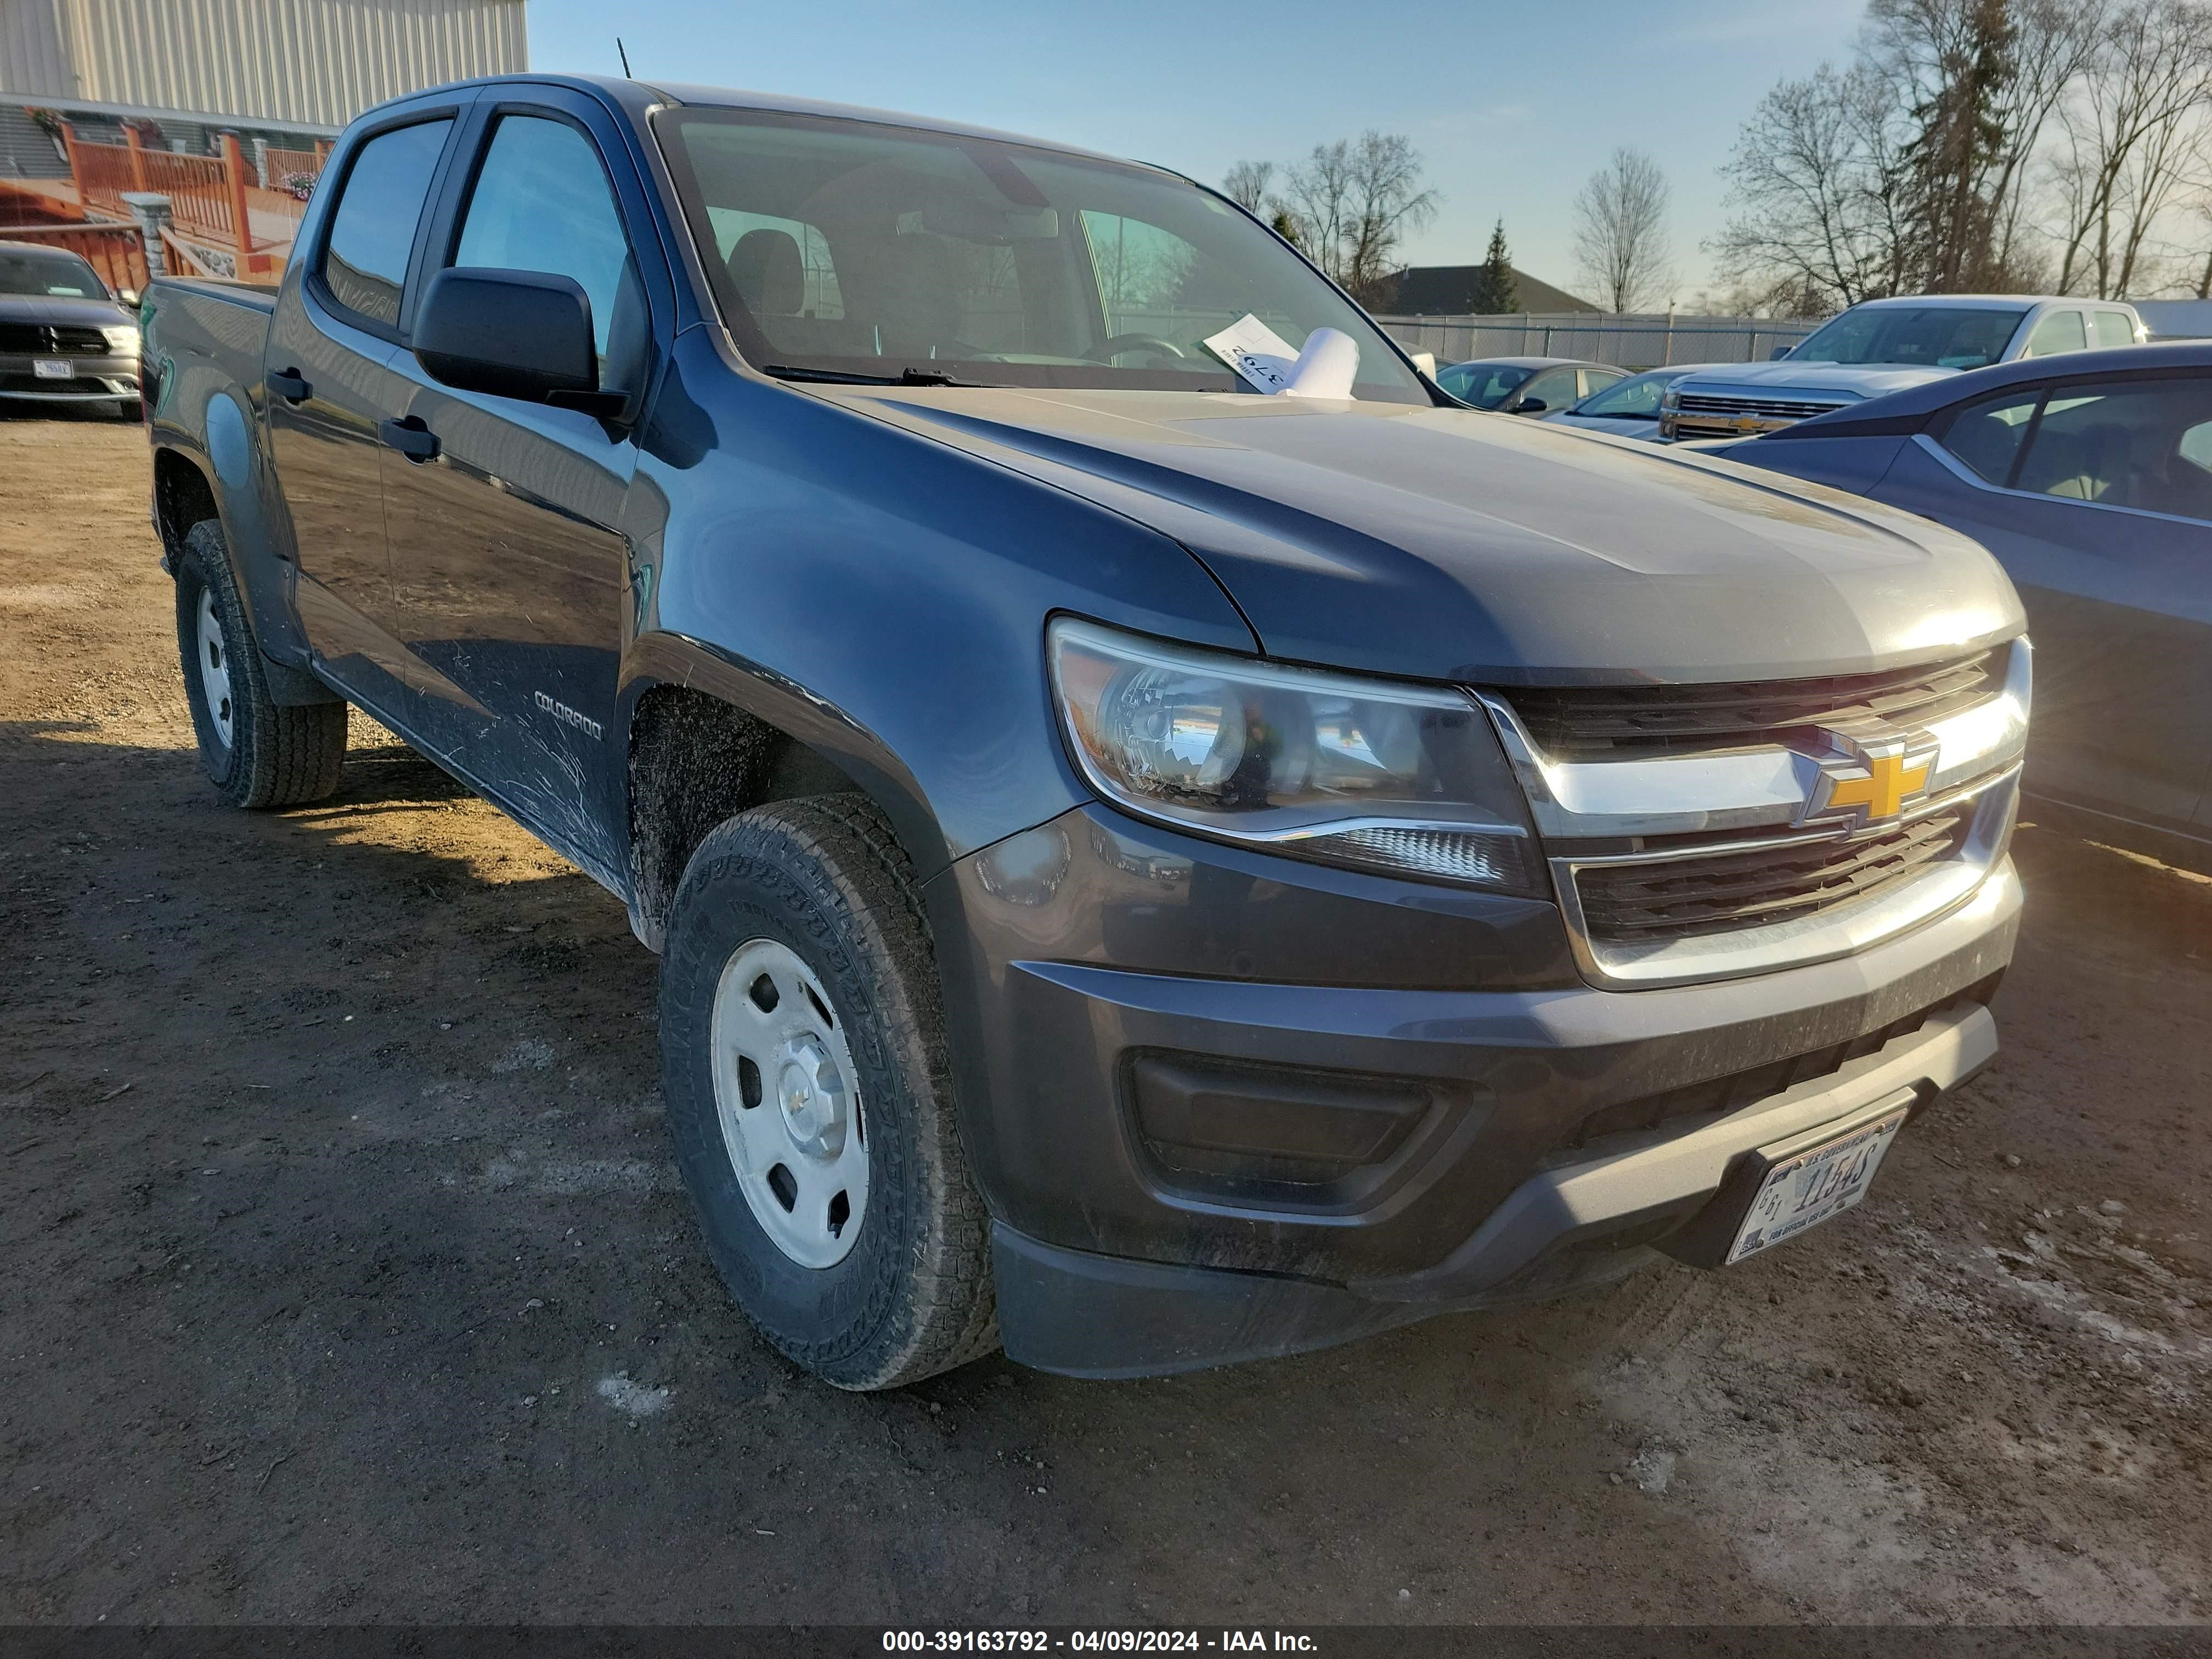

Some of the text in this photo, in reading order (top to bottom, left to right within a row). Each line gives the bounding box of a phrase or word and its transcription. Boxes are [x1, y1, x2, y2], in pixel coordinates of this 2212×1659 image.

[1232, 345, 1284, 386] 3792
[534, 690, 605, 742] COLORADO
[1821, 1131, 1871, 1161] GOVERNMENT
[1794, 1142, 1878, 1213] 1154S
